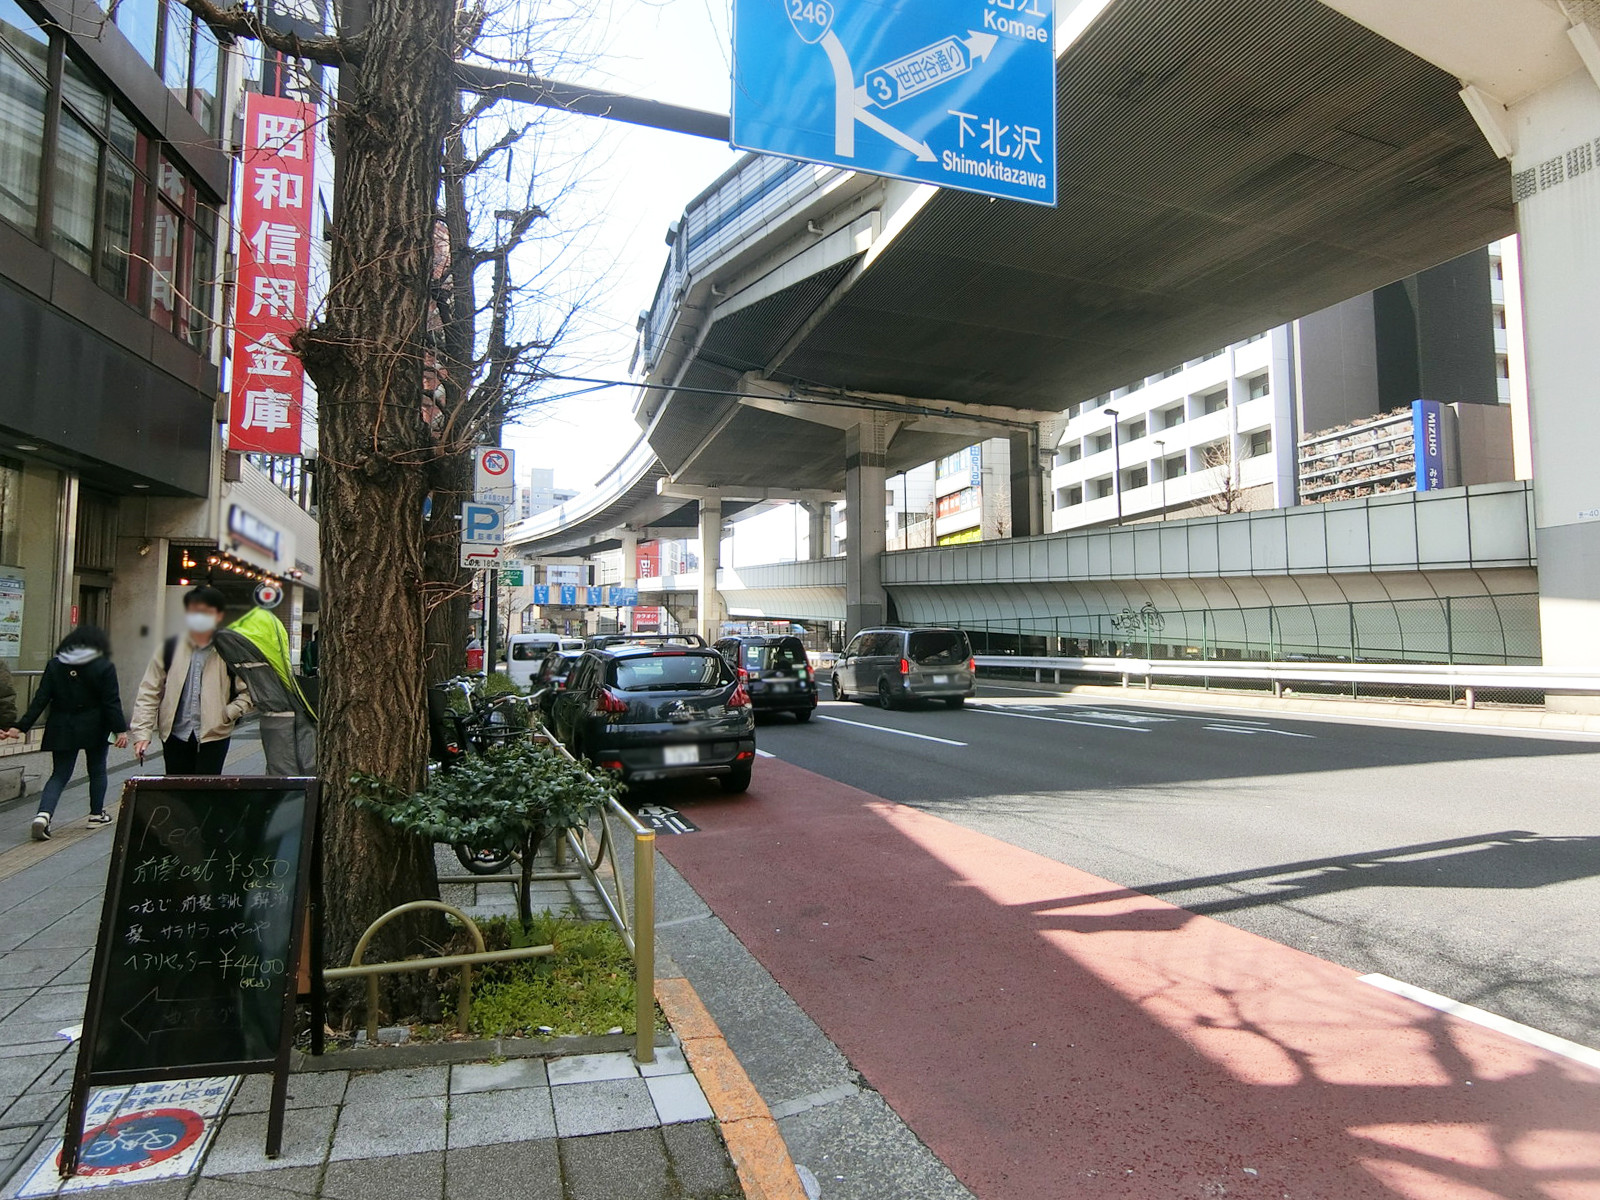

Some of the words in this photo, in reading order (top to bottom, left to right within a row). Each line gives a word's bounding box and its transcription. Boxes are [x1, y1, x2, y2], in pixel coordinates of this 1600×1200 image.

[791, 1, 828, 26] 246
[984, 8, 1048, 43] Komae
[873, 76, 893, 101] 3
[894, 45, 963, 91] 世田谷通り
[947, 109, 1043, 164] 下北沢
[942, 149, 1047, 189] Shimokitazawa
[240, 112, 305, 433] 昭和信用金庫
[1428, 412, 1437, 457] MIZUHO
[467, 506, 500, 540] P
[483, 559, 500, 568] 180m
